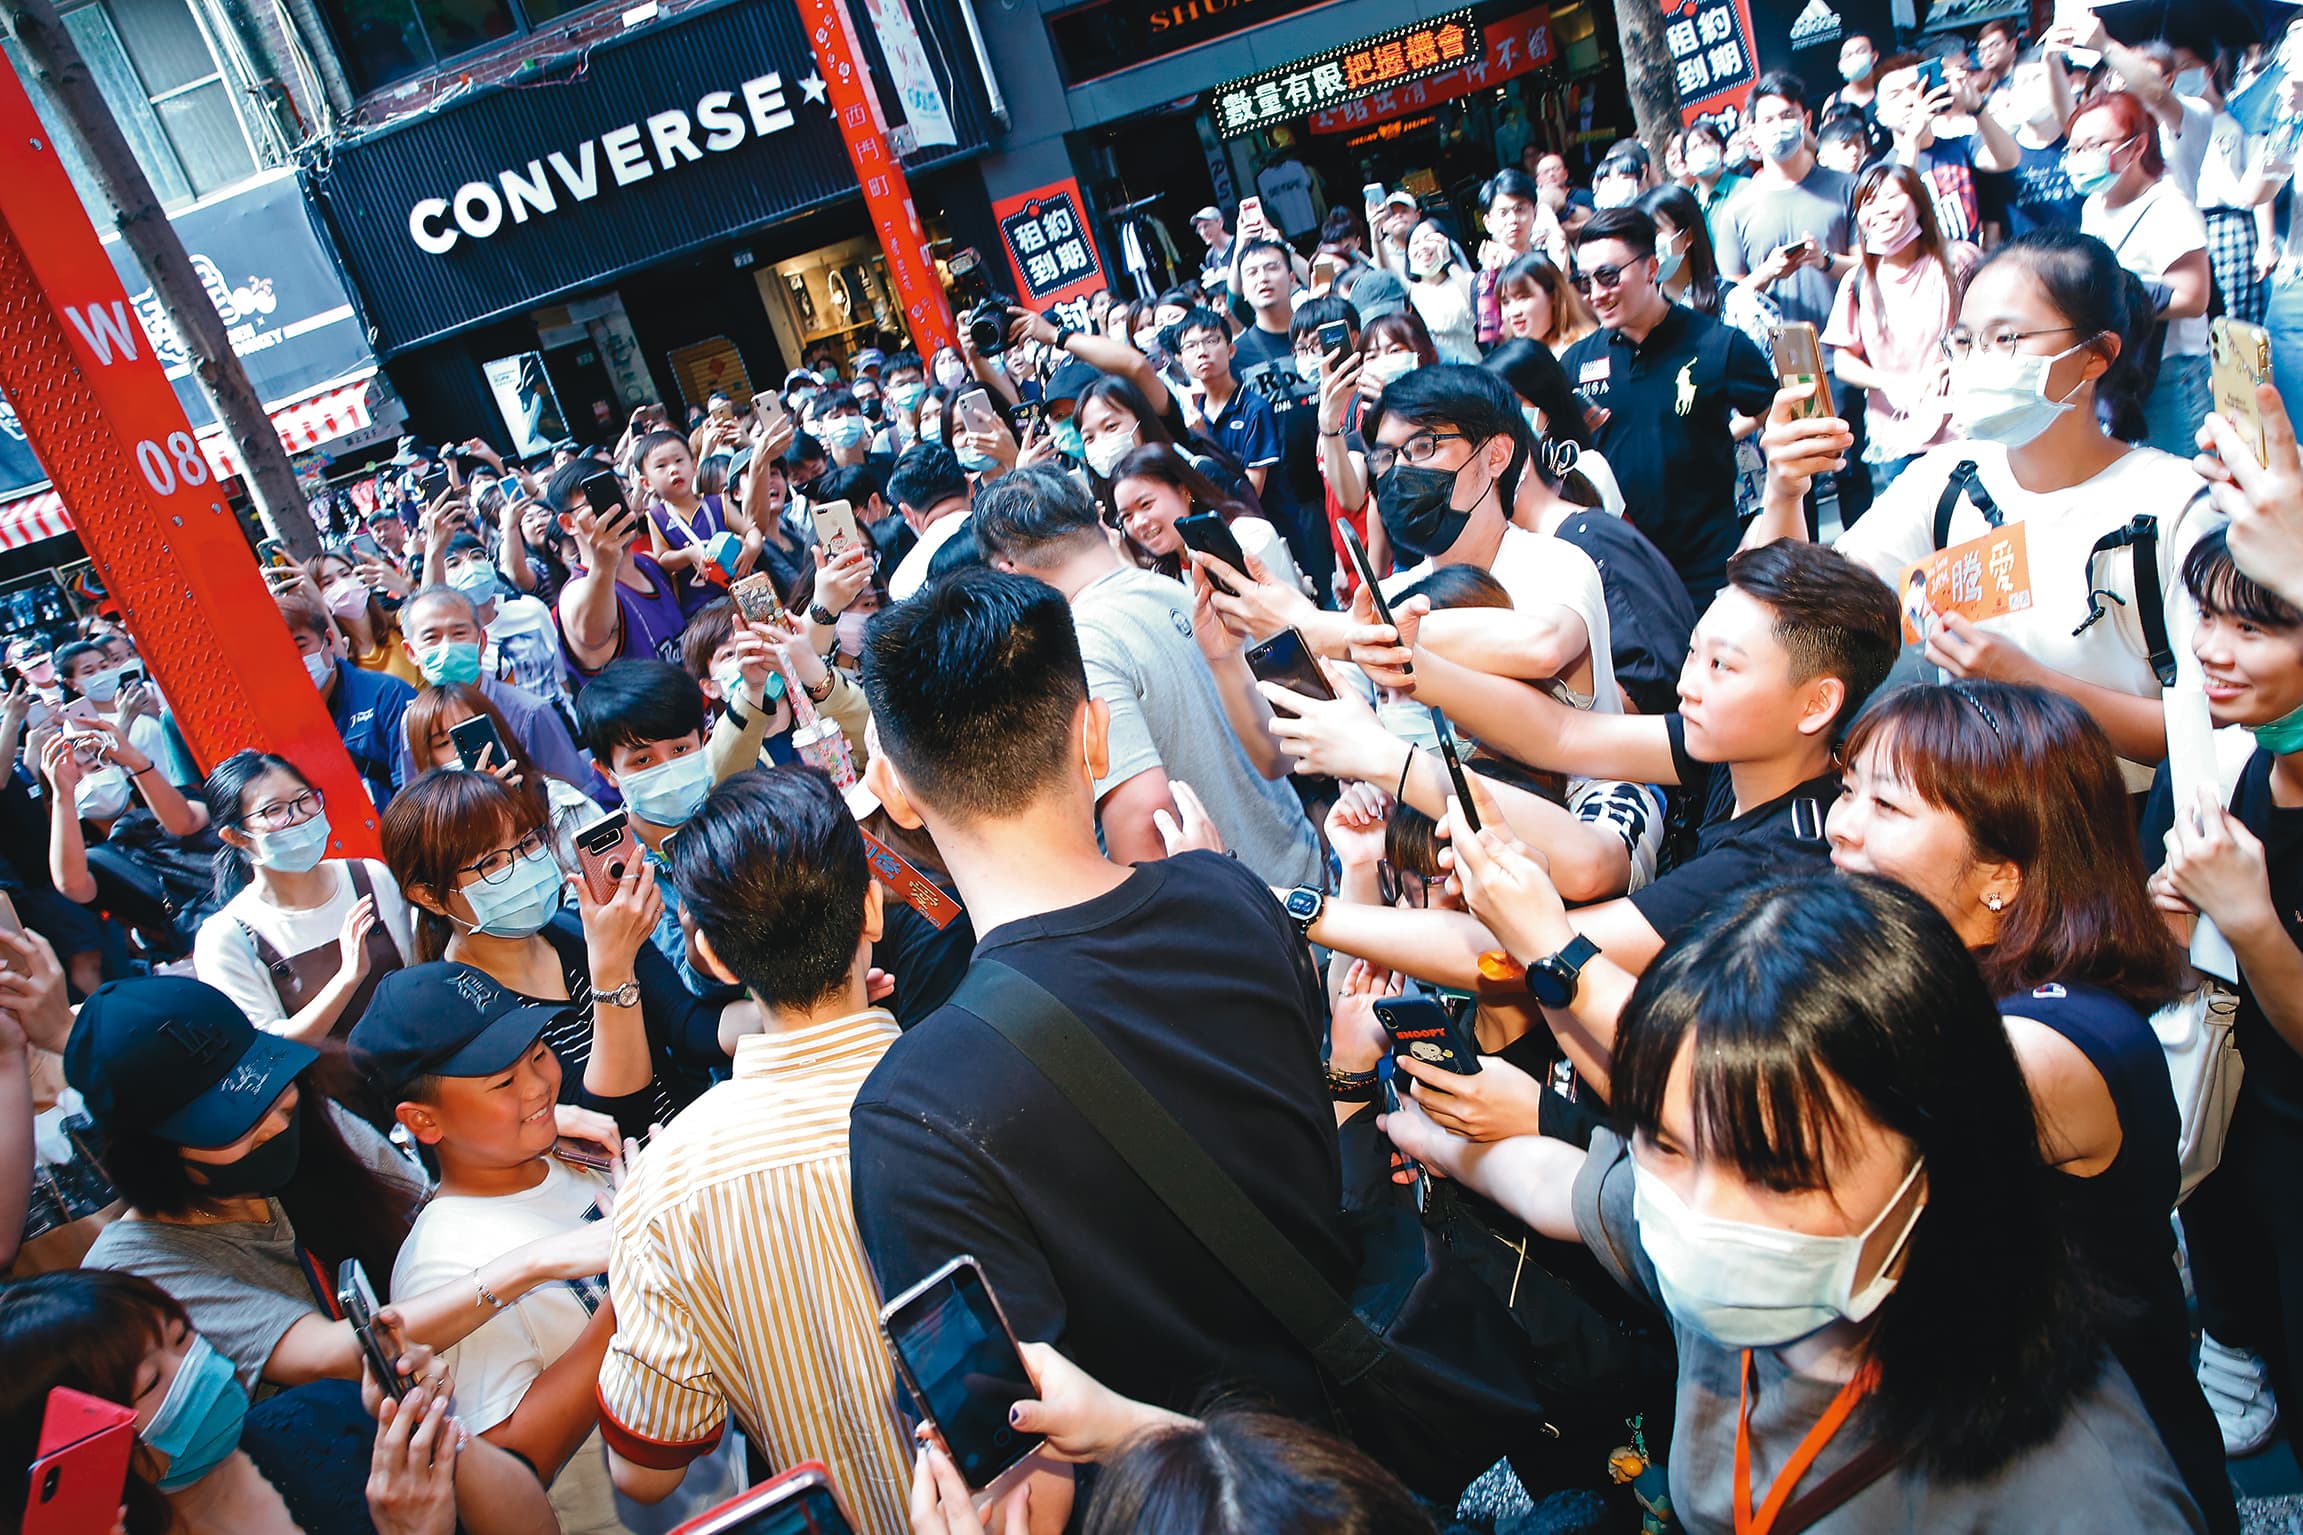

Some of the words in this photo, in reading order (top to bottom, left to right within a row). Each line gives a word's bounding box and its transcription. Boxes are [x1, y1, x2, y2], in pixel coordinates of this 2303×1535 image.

[1150, 0, 1255, 32] SHU
[1665, 5, 1732, 59] 租約
[1675, 39, 1744, 96] 到期
[409, 72, 794, 254] CONVERSE
[844, 102, 890, 198] 西門町
[1013, 207, 1073, 254] 租約
[1026, 237, 1088, 288] 到期
[64, 301, 138, 366] W
[136, 431, 208, 496] 08
[1395, 1027, 1446, 1041] SNOOPY
